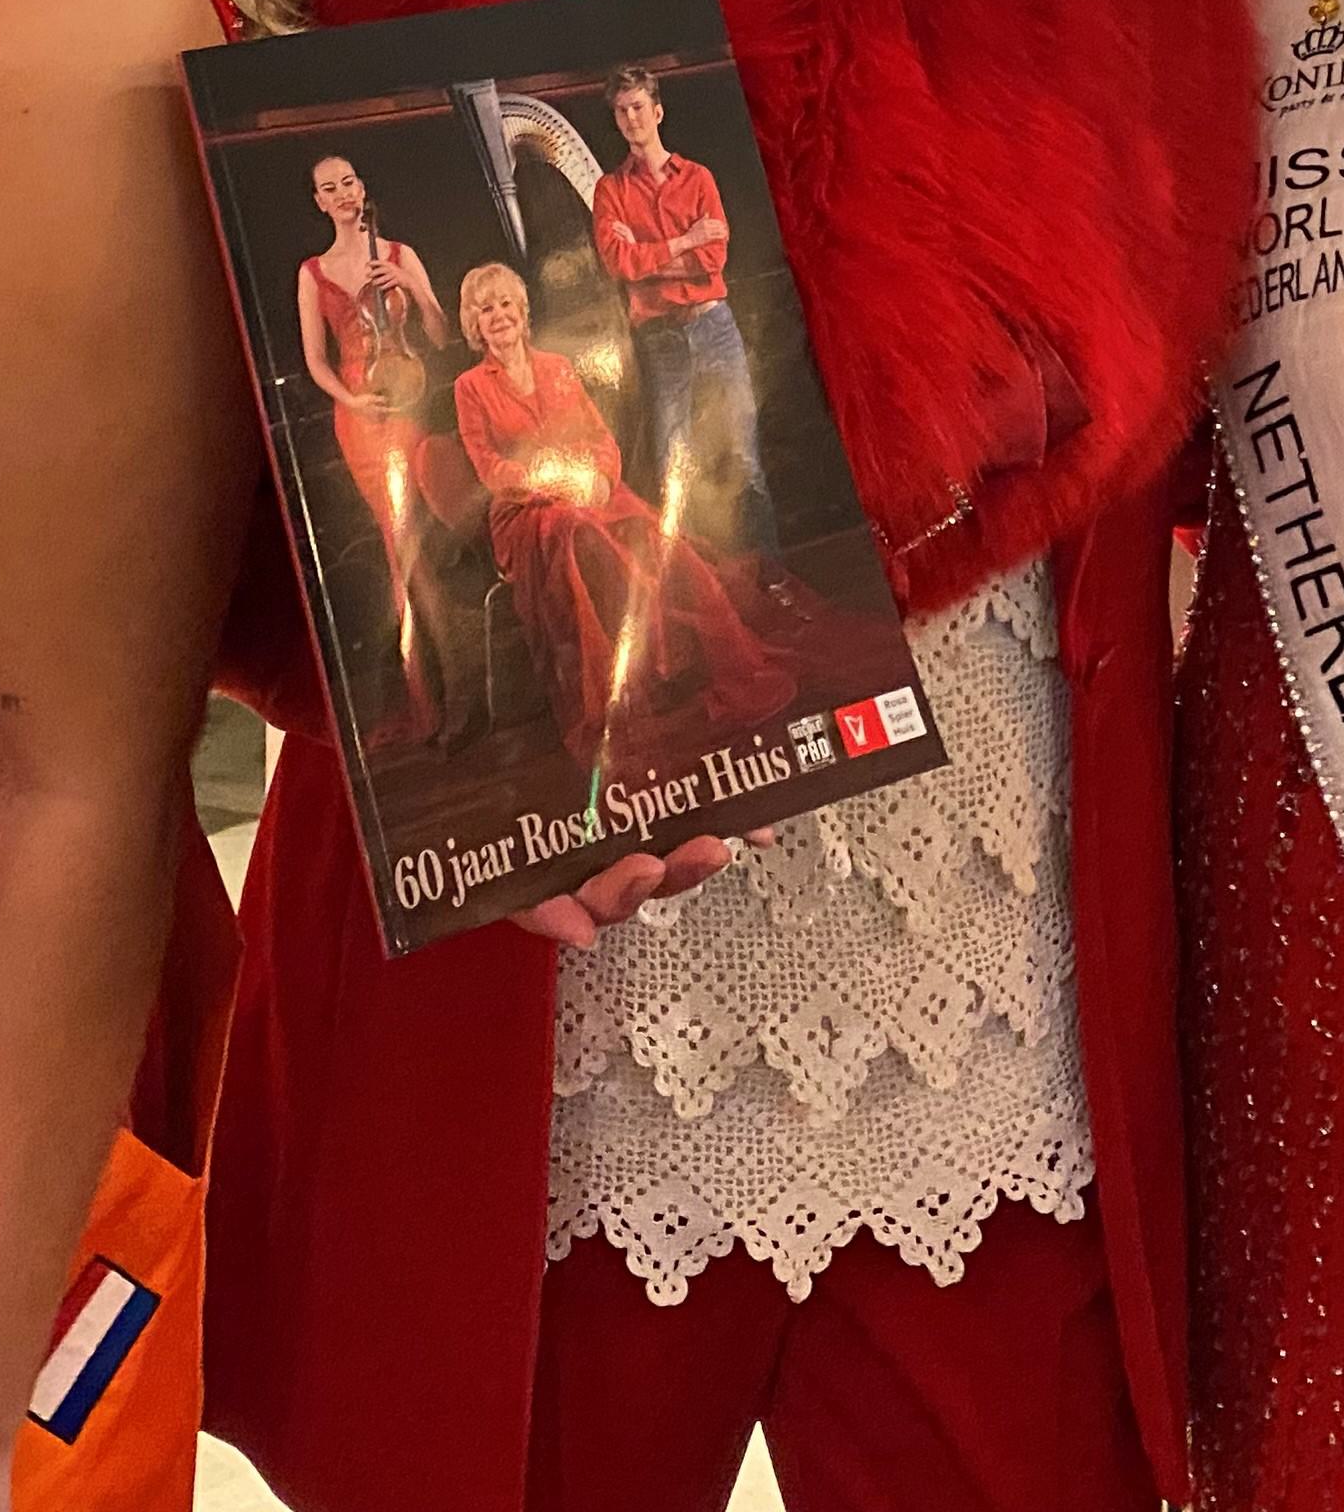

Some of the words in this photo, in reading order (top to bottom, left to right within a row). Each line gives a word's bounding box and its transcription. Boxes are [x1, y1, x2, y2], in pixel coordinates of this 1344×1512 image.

[1279, 99, 1315, 118] party
[393, 847, 446, 909] 60
[445, 837, 515, 908] jaar
[516, 806, 606, 867] Rosa
[605, 768, 701, 842] Spier
[700, 734, 792, 803] Huis
